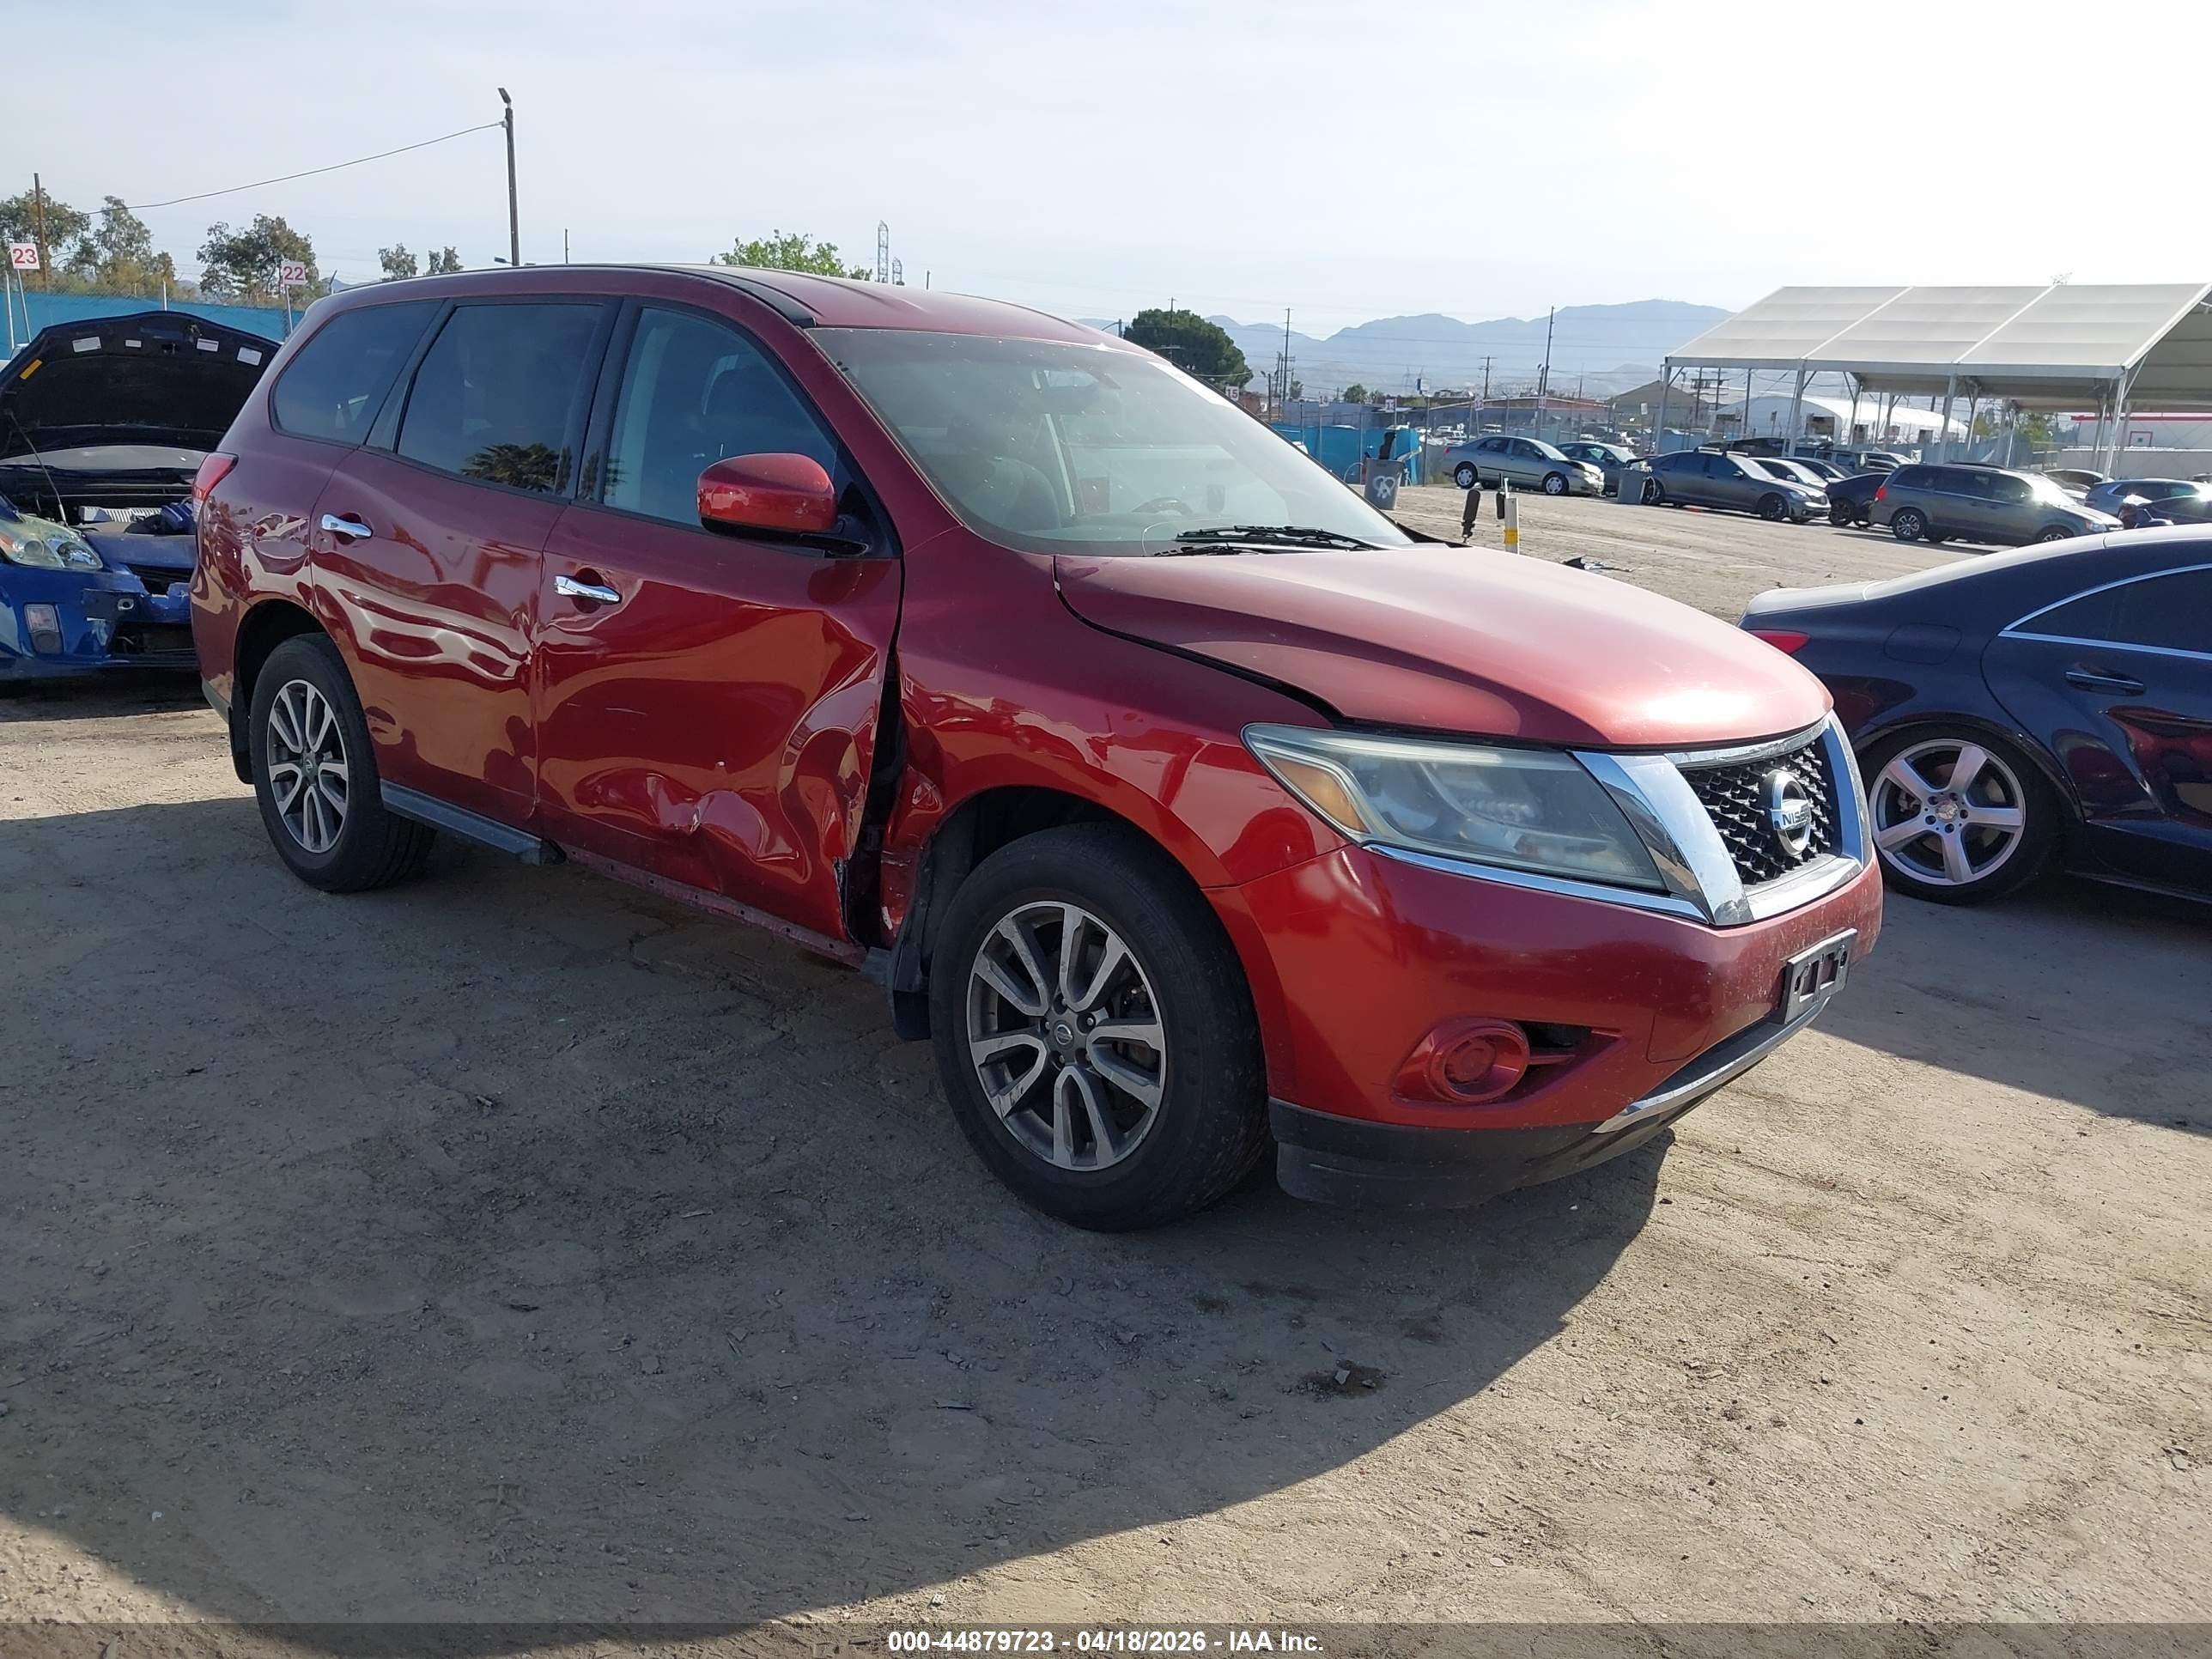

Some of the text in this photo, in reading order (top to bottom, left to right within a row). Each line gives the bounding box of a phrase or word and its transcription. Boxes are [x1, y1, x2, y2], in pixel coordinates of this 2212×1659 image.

[13, 248, 37, 264] 23
[283, 266, 305, 280] 22
[1228, 389, 1237, 398] 15
